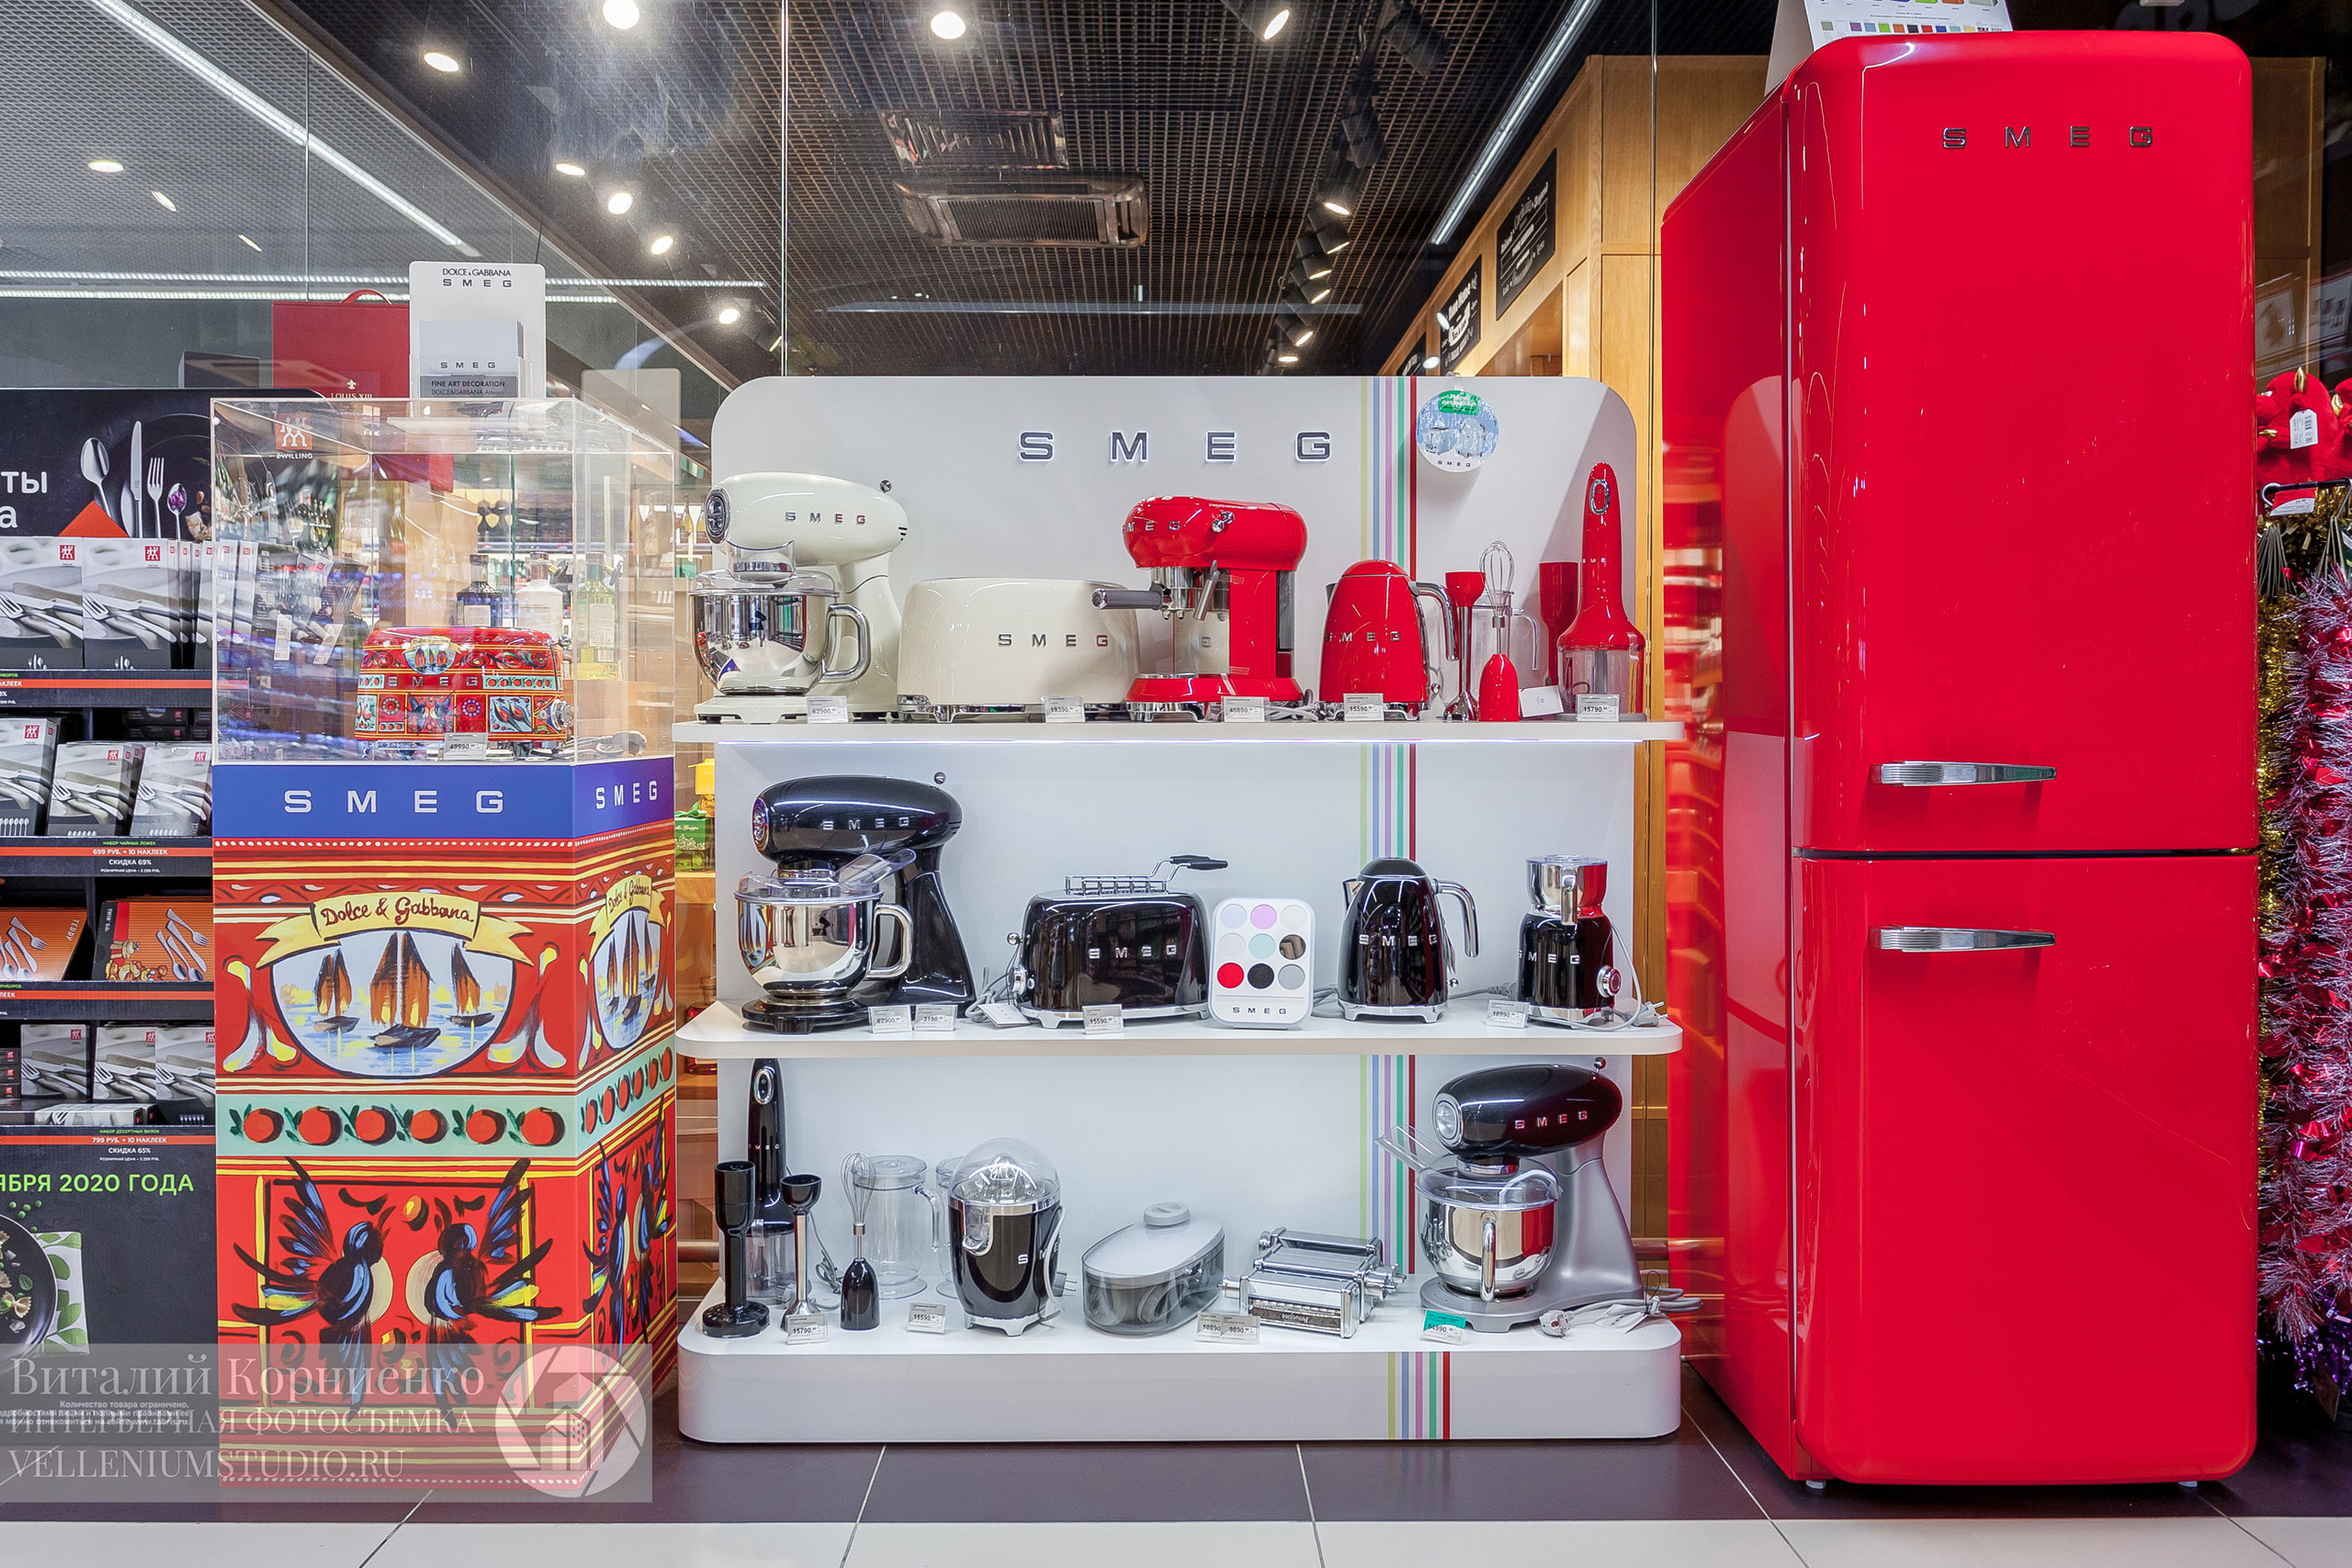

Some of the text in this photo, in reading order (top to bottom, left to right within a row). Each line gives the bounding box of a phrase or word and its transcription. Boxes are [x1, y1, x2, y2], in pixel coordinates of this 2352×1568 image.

[1942, 126, 2154, 150] SMEG
[443, 279, 512, 288] SMEG
[1019, 430, 1331, 462] SMEG
[786, 511, 866, 525] SMEG
[1123, 520, 1181, 533] MEG
[998, 633, 1108, 647] SMEG
[388, 676, 478, 687] SMEG
[284, 790, 504, 814] SMEG
[595, 780, 658, 809] SMEG
[820, 816, 910, 831] SMEG
[322, 901, 371, 926] Dolce
[375, 897, 390, 919] &
[65, 919, 80, 942] TEDDY
[1359, 933, 1438, 947] SMEG
[1089, 944, 1177, 959] SMEG
[1232, 1007, 1286, 1015] SMEG
[1514, 1111, 1588, 1130] SMEG
[59, 1174, 120, 1192] 2020
[129, 1174, 194, 1196] ГОДА
